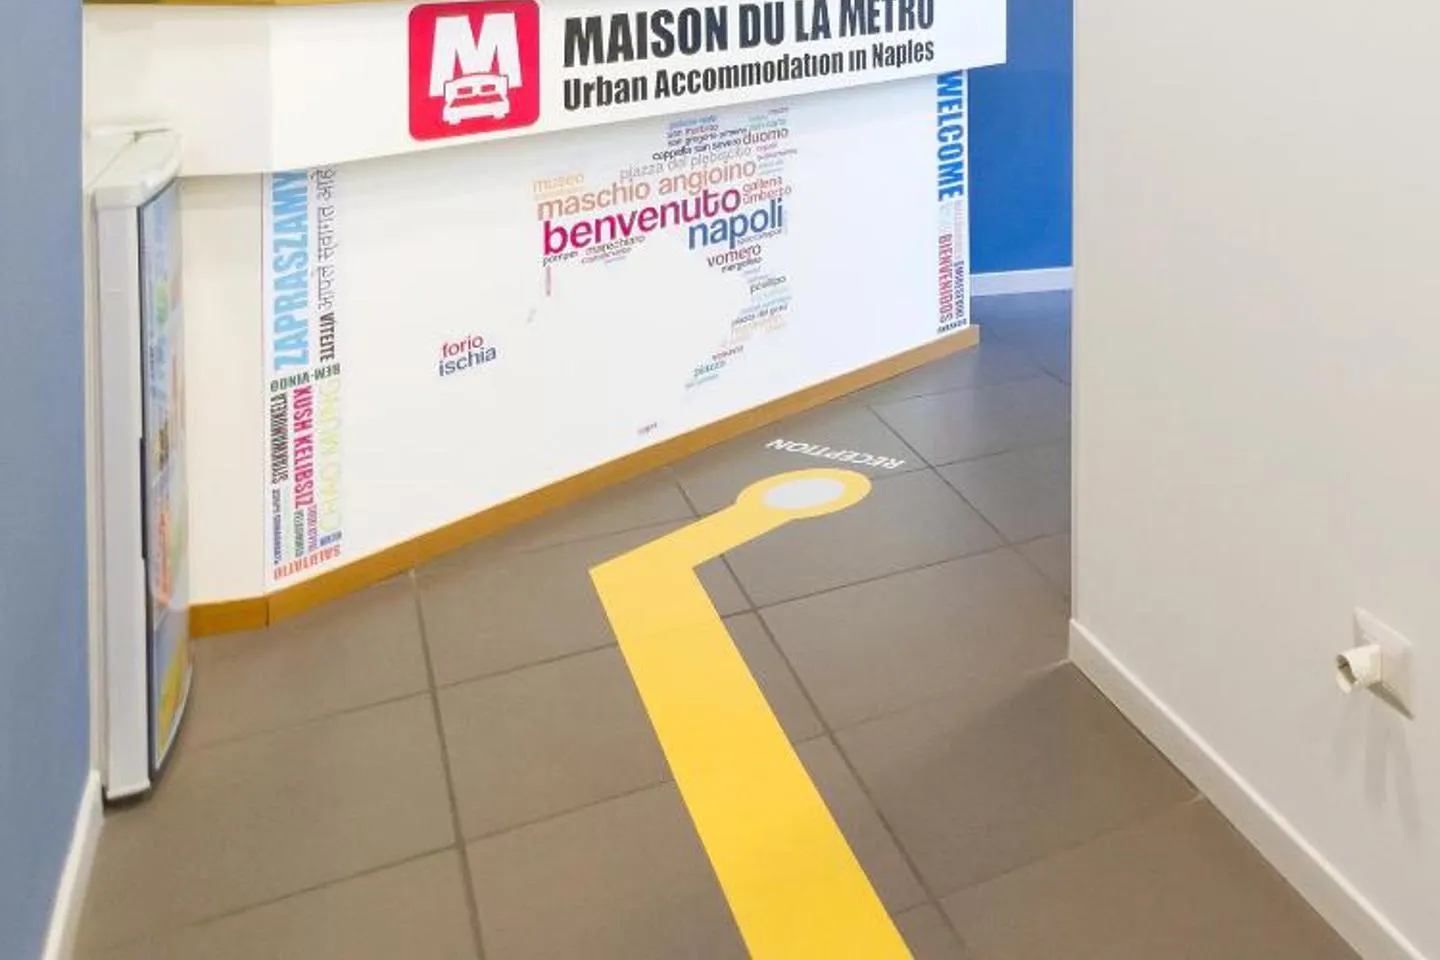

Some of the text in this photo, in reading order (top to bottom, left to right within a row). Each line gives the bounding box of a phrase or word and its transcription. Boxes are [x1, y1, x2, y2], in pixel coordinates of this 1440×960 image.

[564, 5, 729, 68] MAISON
[738, 1, 784, 49] DU
[563, 74, 648, 111] Urban
[655, 50, 844, 99] Accommodation
[871, 38, 935, 70] Naples
[742, 127, 789, 146] duomo
[937, 70, 964, 202] WELCOME
[533, 172, 584, 194] museo
[537, 159, 757, 221] maschio angioino
[619, 160, 664, 183] piazza
[667, 152, 688, 172] del
[543, 188, 742, 256] benvenuto
[688, 197, 783, 250] napoli
[271, 169, 309, 371] ZAPRASZAMY
[707, 243, 762, 267] vomero
[938, 233, 954, 323] BIENVENIDOS
[439, 346, 497, 377] ischia
[442, 334, 484, 358] forio
[293, 385, 313, 433] KUSH
[293, 433, 315, 510] KELIBSIZ
[764, 438, 906, 470] RECEPTION
